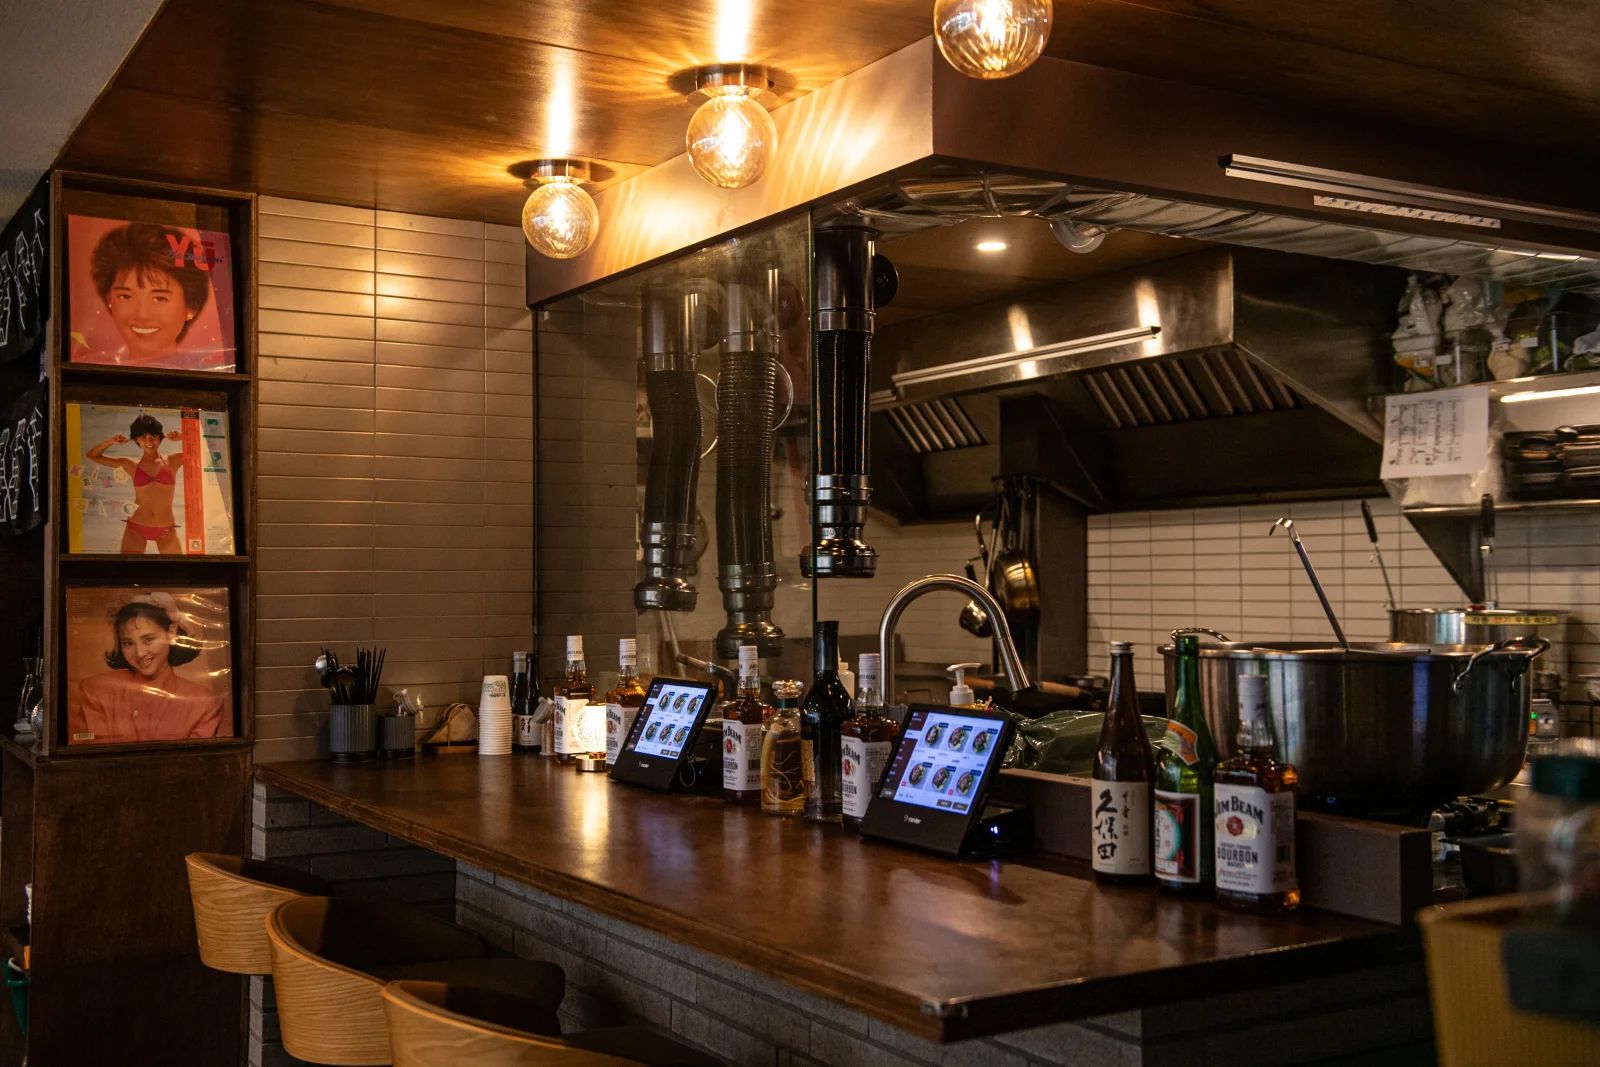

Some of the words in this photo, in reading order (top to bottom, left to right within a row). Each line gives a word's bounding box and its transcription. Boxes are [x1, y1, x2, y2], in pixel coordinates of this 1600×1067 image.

[1094, 788, 1118, 860] 久保田
[1231, 795, 1264, 824] BEAM
